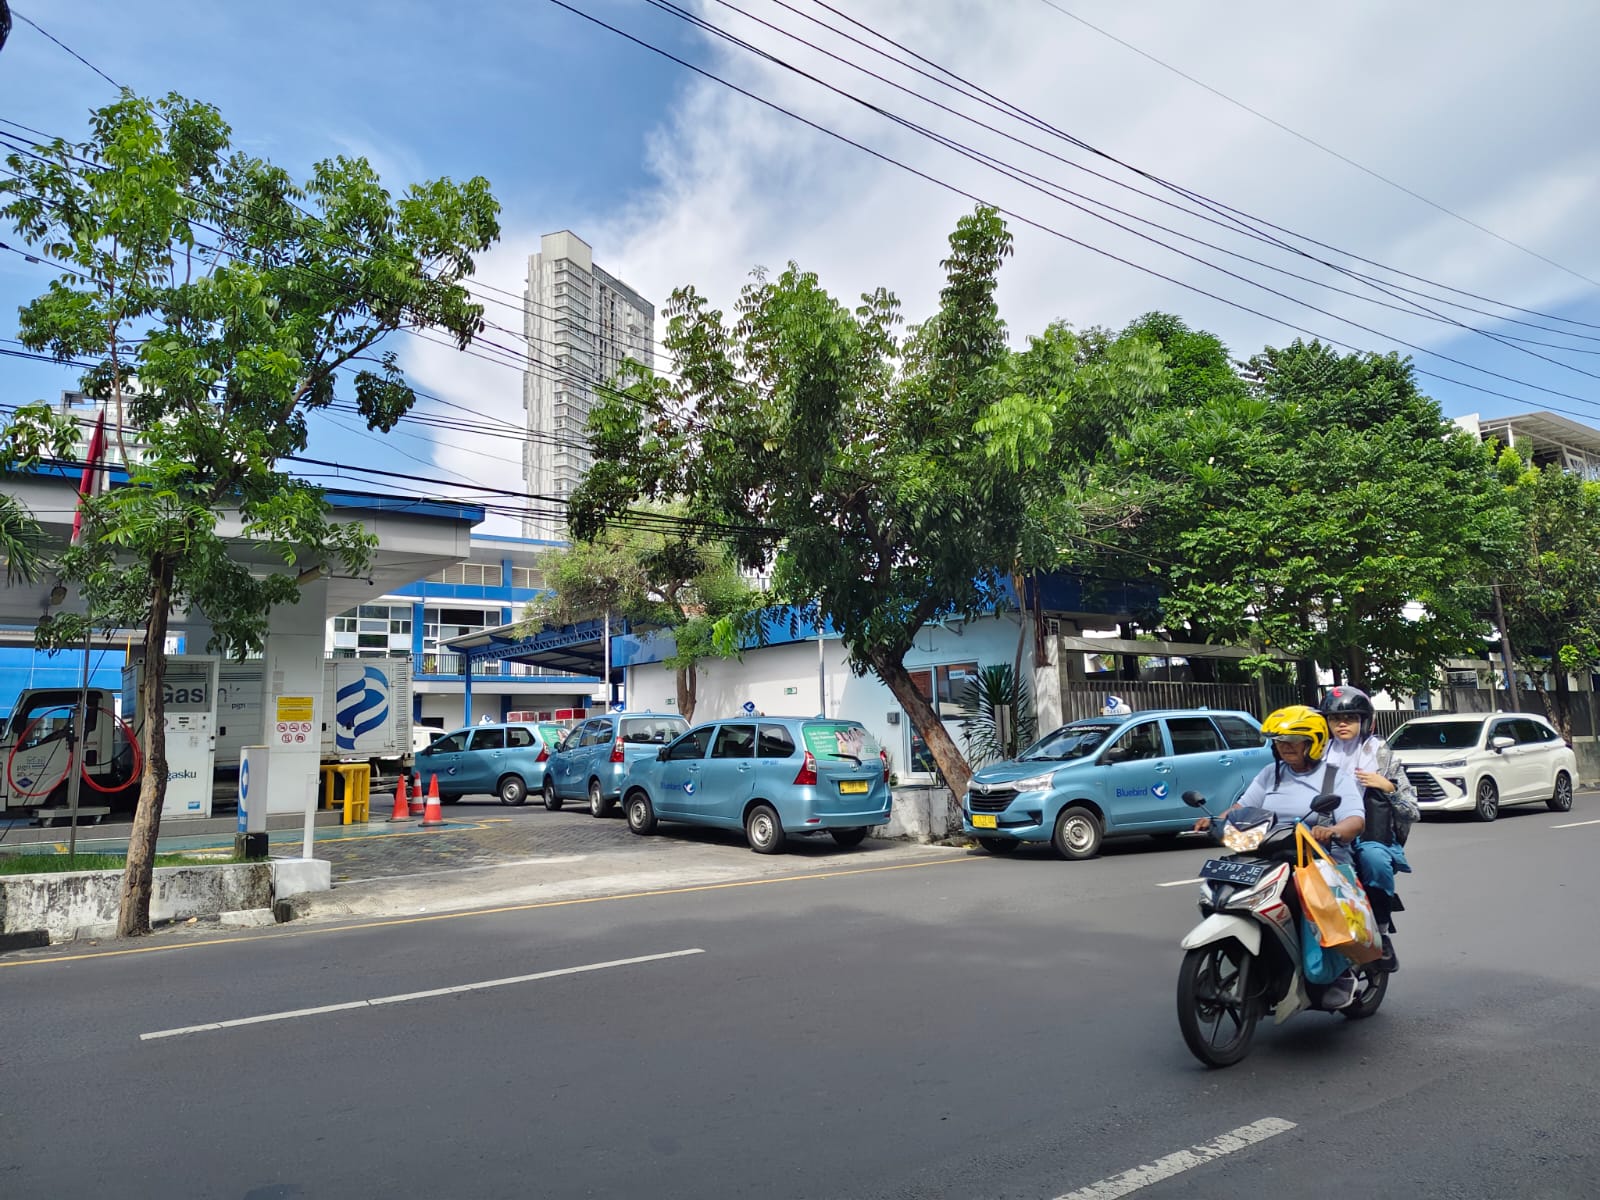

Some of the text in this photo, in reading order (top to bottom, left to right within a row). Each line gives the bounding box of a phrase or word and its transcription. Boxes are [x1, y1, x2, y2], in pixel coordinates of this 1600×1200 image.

[1116, 788, 1148, 798] Bluebird
[1206, 861, 1262, 876] L 2797 JE
